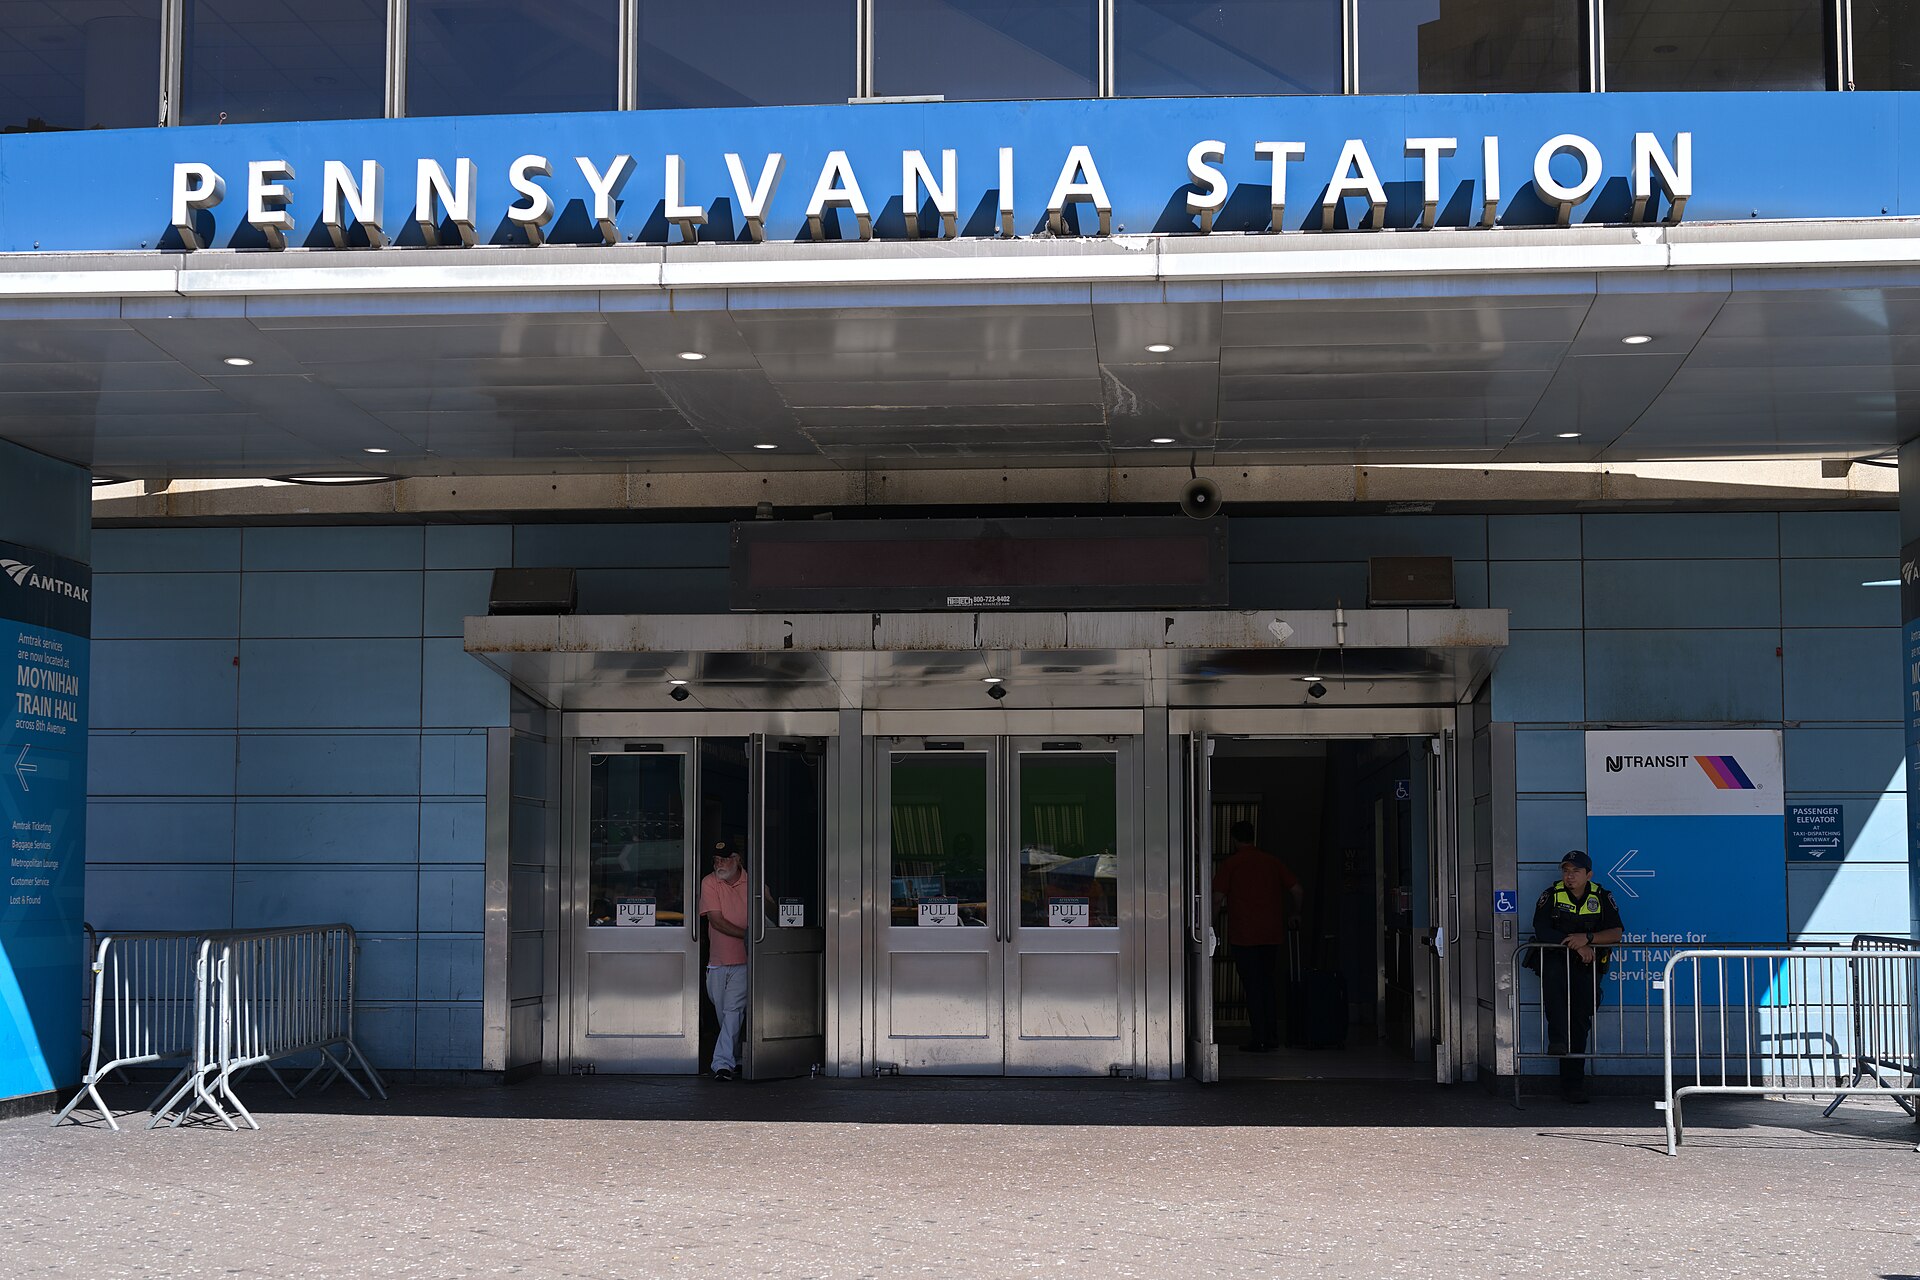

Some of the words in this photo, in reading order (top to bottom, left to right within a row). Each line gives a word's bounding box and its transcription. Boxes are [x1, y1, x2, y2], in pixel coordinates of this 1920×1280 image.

[171, 144, 1111, 228] PENNSYLVANIA
[1186, 131, 1692, 214] STATION
[29, 574, 88, 602] AMTRAK
[18, 632, 41, 647] Amtrak
[42, 640, 62, 652] services
[18, 650, 28, 660] are
[30, 652, 43, 662] now
[44, 652, 64, 667] located
[64, 659, 70, 668] at
[18, 665, 78, 696] MOYNIHAN
[16, 692, 52, 718] TRAIN
[54, 699, 78, 722] HALL
[16, 720, 34, 730] across
[36, 720, 46, 731] 8th
[47, 722, 66, 734] Avenue
[12, 820, 31, 830] Amtrak
[32, 822, 52, 834] Ticketing
[12, 840, 33, 850] Baggage
[34, 840, 52, 850] Services
[11, 858, 42, 869] Metropolitan
[43, 859, 58, 870] Lounge
[10, 876, 34, 886] Customer
[34, 876, 50, 886] Service
[10, 896, 20, 904] Lost
[22, 896, 26, 904] &
[26, 896, 41, 904] Found
[619, 904, 654, 916] PULL
[781, 906, 802, 916] PULL
[921, 904, 956, 916] PULL
[1052, 905, 1087, 916] PULL
[1620, 932, 1646, 943] nter
[1651, 932, 1682, 943] here
[1686, 932, 1706, 943] for
[1610, 950, 1628, 962] NJ
